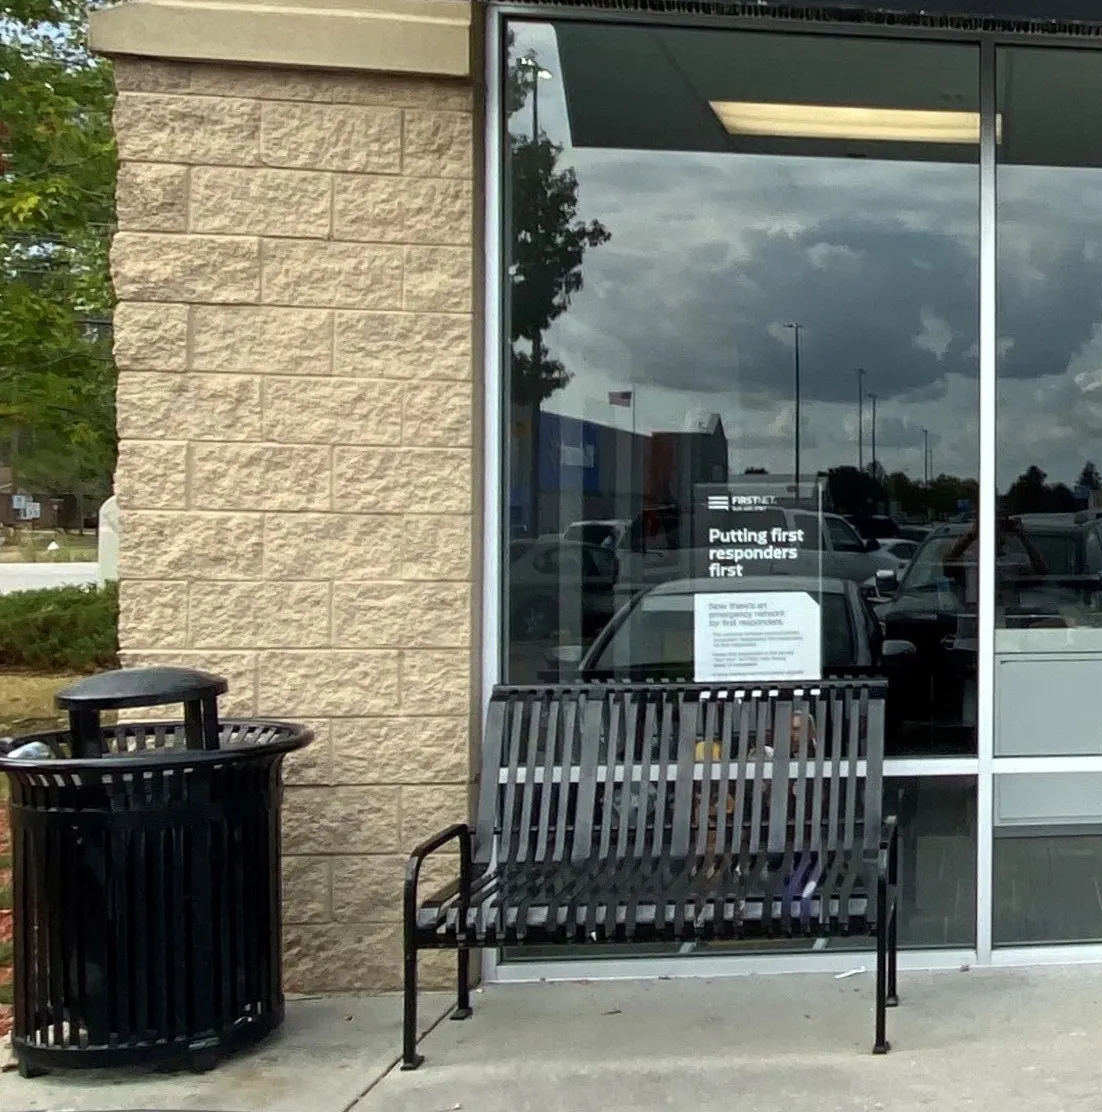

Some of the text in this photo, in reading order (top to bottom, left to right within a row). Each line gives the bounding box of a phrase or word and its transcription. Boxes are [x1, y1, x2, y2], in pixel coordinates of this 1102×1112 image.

[709, 527, 804, 545] Putting first
[709, 546, 798, 562] responders
[709, 562, 743, 577] first
